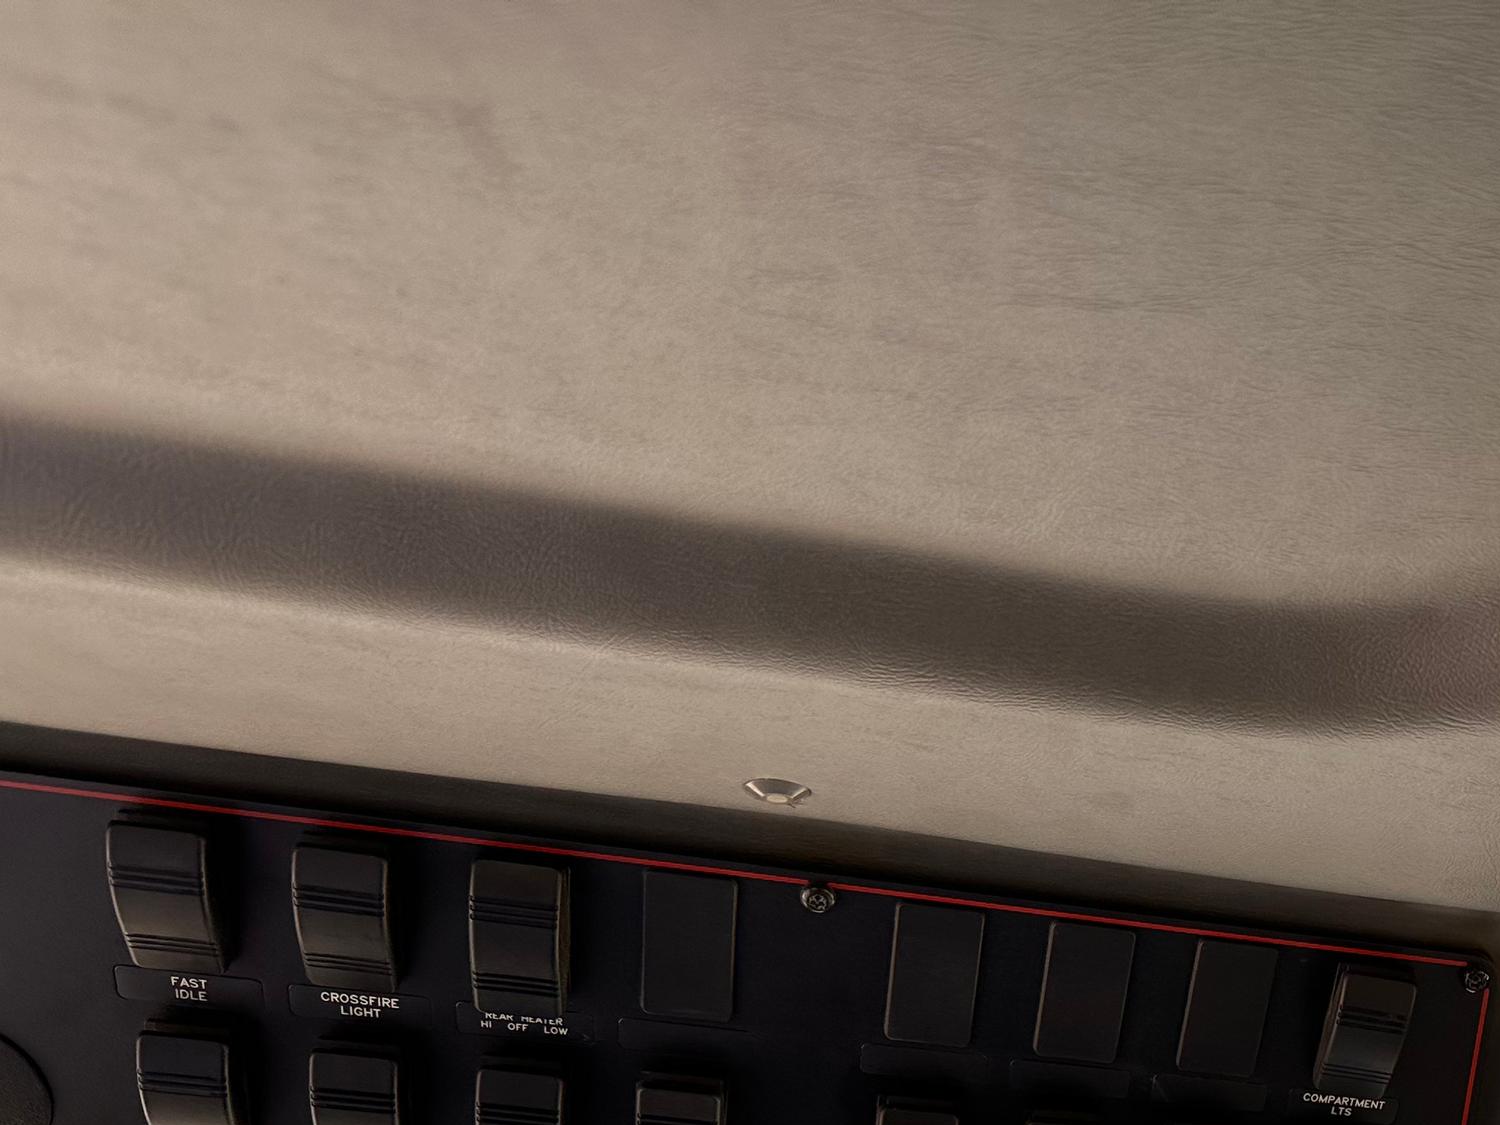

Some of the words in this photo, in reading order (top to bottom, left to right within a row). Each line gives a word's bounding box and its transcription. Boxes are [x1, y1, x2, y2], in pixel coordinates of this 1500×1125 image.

[170, 976, 208, 990] FAST
[174, 987, 208, 1002] IDLE
[320, 991, 400, 1009] CROSSFIRE
[340, 1005, 382, 1018] LIGHT
[480, 1020, 492, 1029] HI
[507, 1022, 529, 1031] OFF
[543, 1025, 568, 1035] LOW
[1303, 1092, 1386, 1110] COMPARTMENT
[1330, 1106, 1352, 1117] LTS
